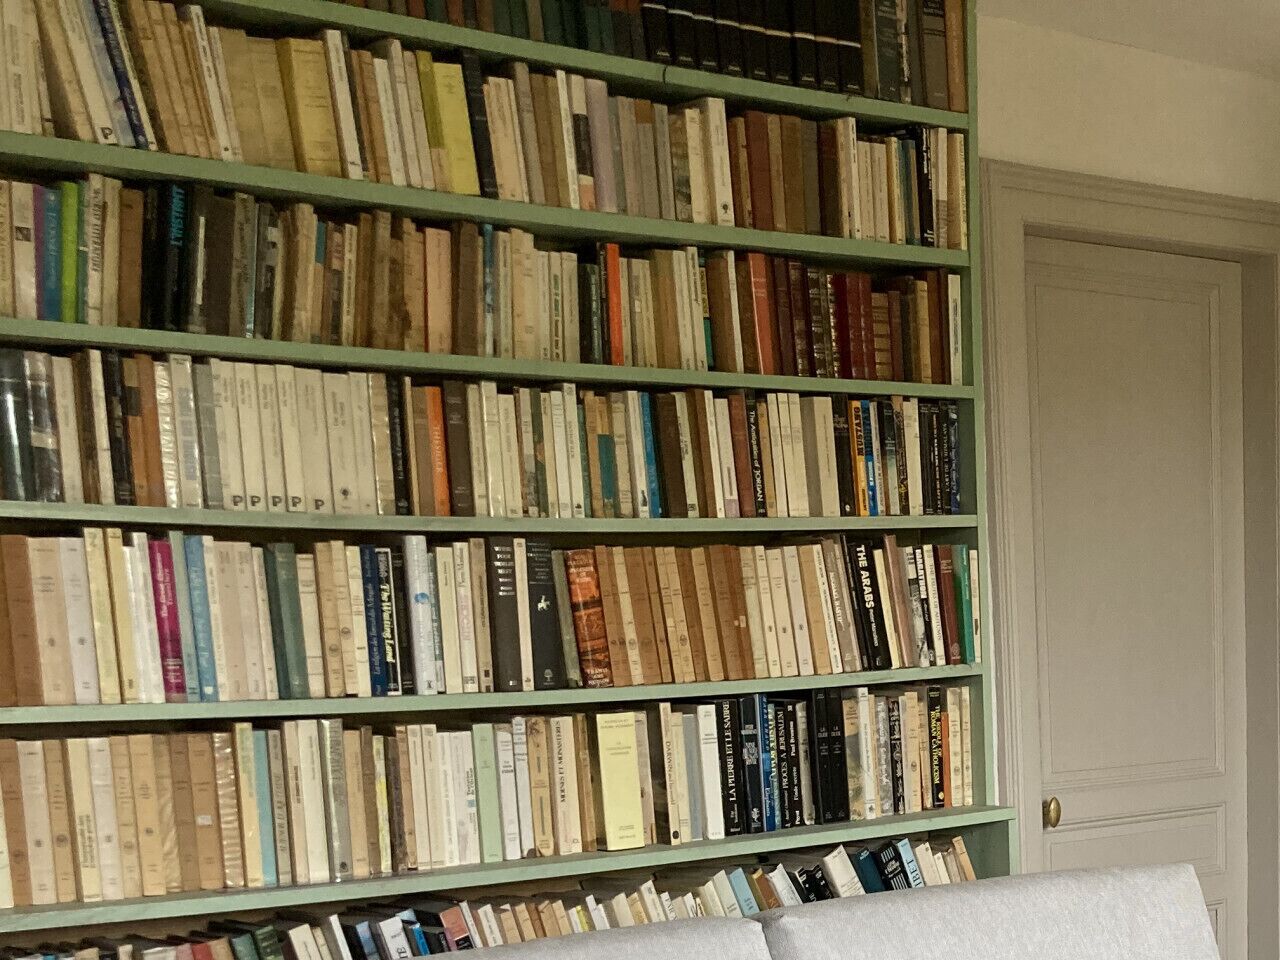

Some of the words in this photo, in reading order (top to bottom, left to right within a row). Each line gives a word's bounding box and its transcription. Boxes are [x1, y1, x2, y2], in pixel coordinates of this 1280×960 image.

[750, 424, 760, 455] Antiquities
[753, 469, 764, 502] JORDAN
[232, 495, 243, 507] P
[250, 495, 261, 507] P
[271, 495, 283, 507] P
[291, 496, 302, 507] P
[314, 499, 325, 510] P
[856, 544, 868, 567] THE
[915, 549, 927, 599] MARATHON
[381, 583, 391, 601] The
[861, 570, 874, 609] ARABS
[381, 601, 394, 638] Waiting
[384, 639, 396, 663] Land
[723, 700, 731, 728] SABRE
[724, 729, 732, 741] LE
[665, 740, 673, 772] DARWIN
[725, 743, 733, 754] ET
[726, 755, 736, 787] PIERRE
[931, 738, 940, 784] CATHOLICISM
[729, 788, 737, 801] LA
